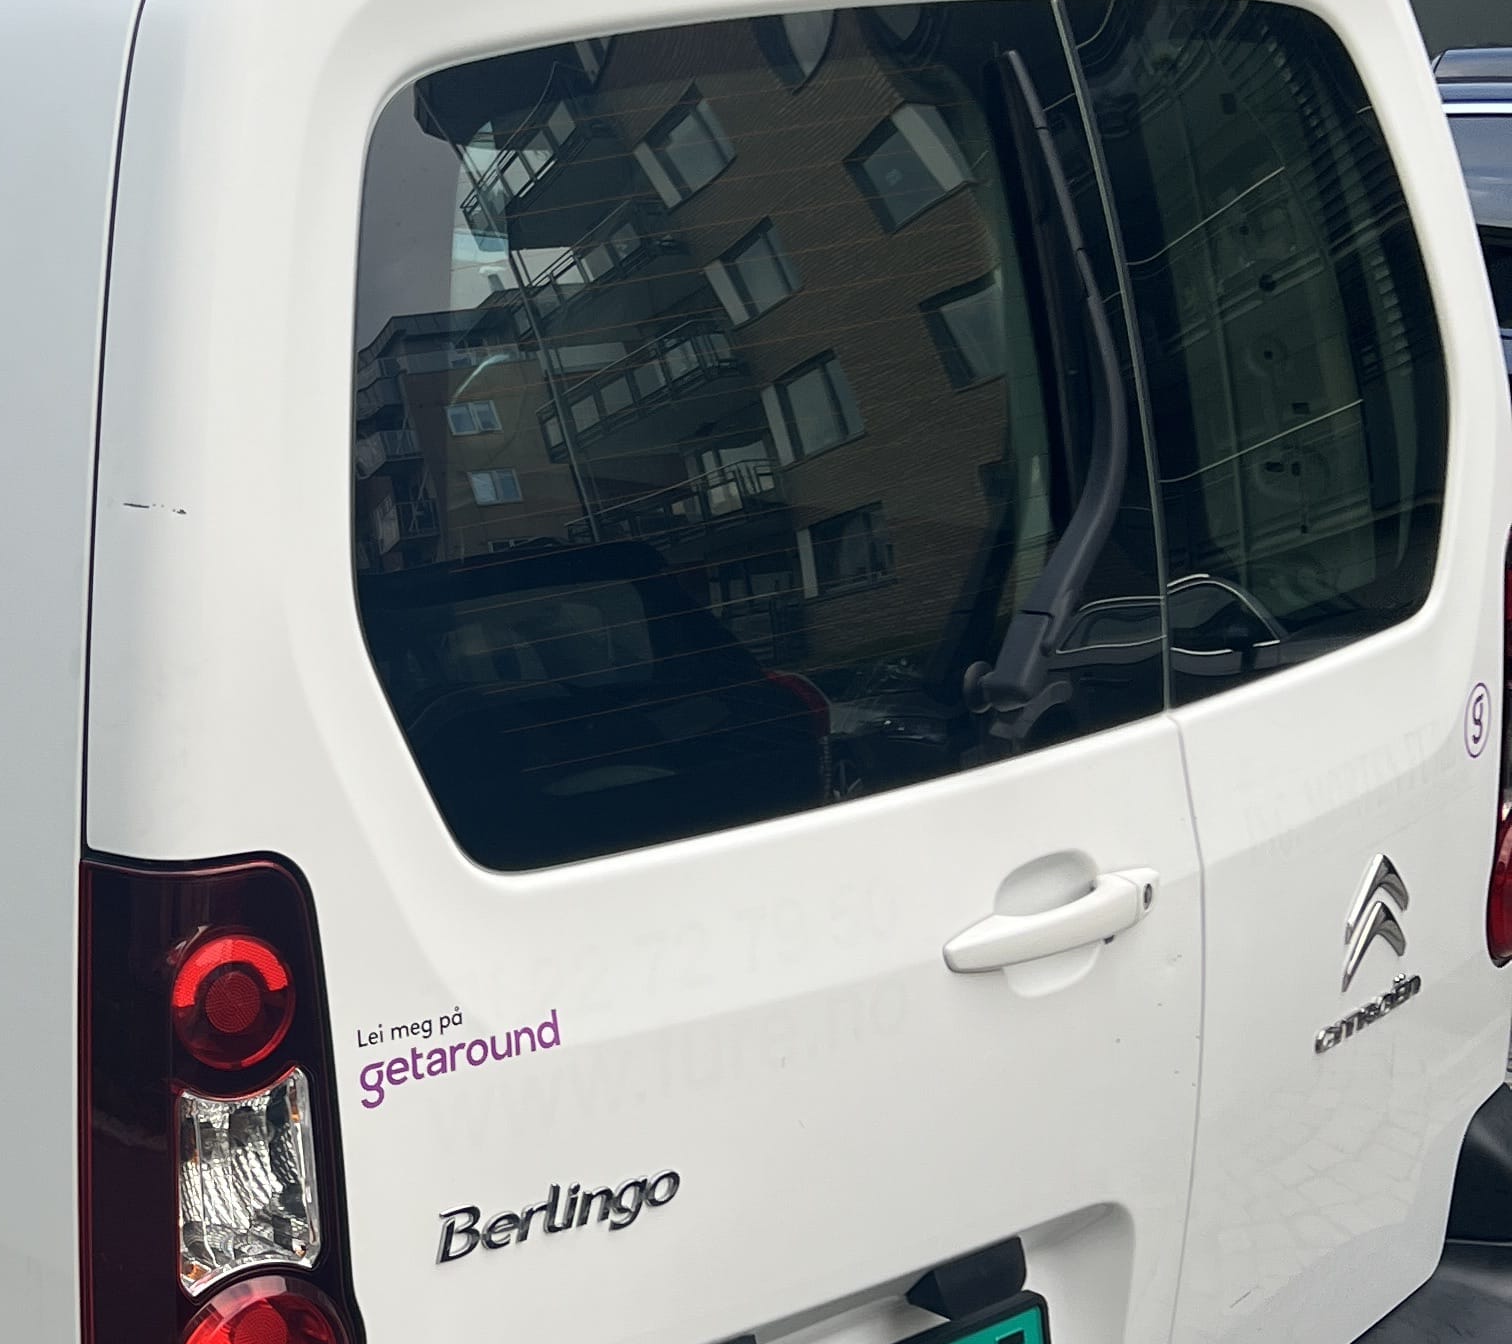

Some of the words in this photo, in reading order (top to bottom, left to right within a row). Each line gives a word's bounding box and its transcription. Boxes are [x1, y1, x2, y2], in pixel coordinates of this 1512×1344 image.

[357, 1023, 384, 1048] Lei
[390, 1019, 433, 1041] meg
[439, 1006, 464, 1036] på
[359, 1008, 561, 1109] getaround
[435, 1169, 681, 1265] Berlingo
